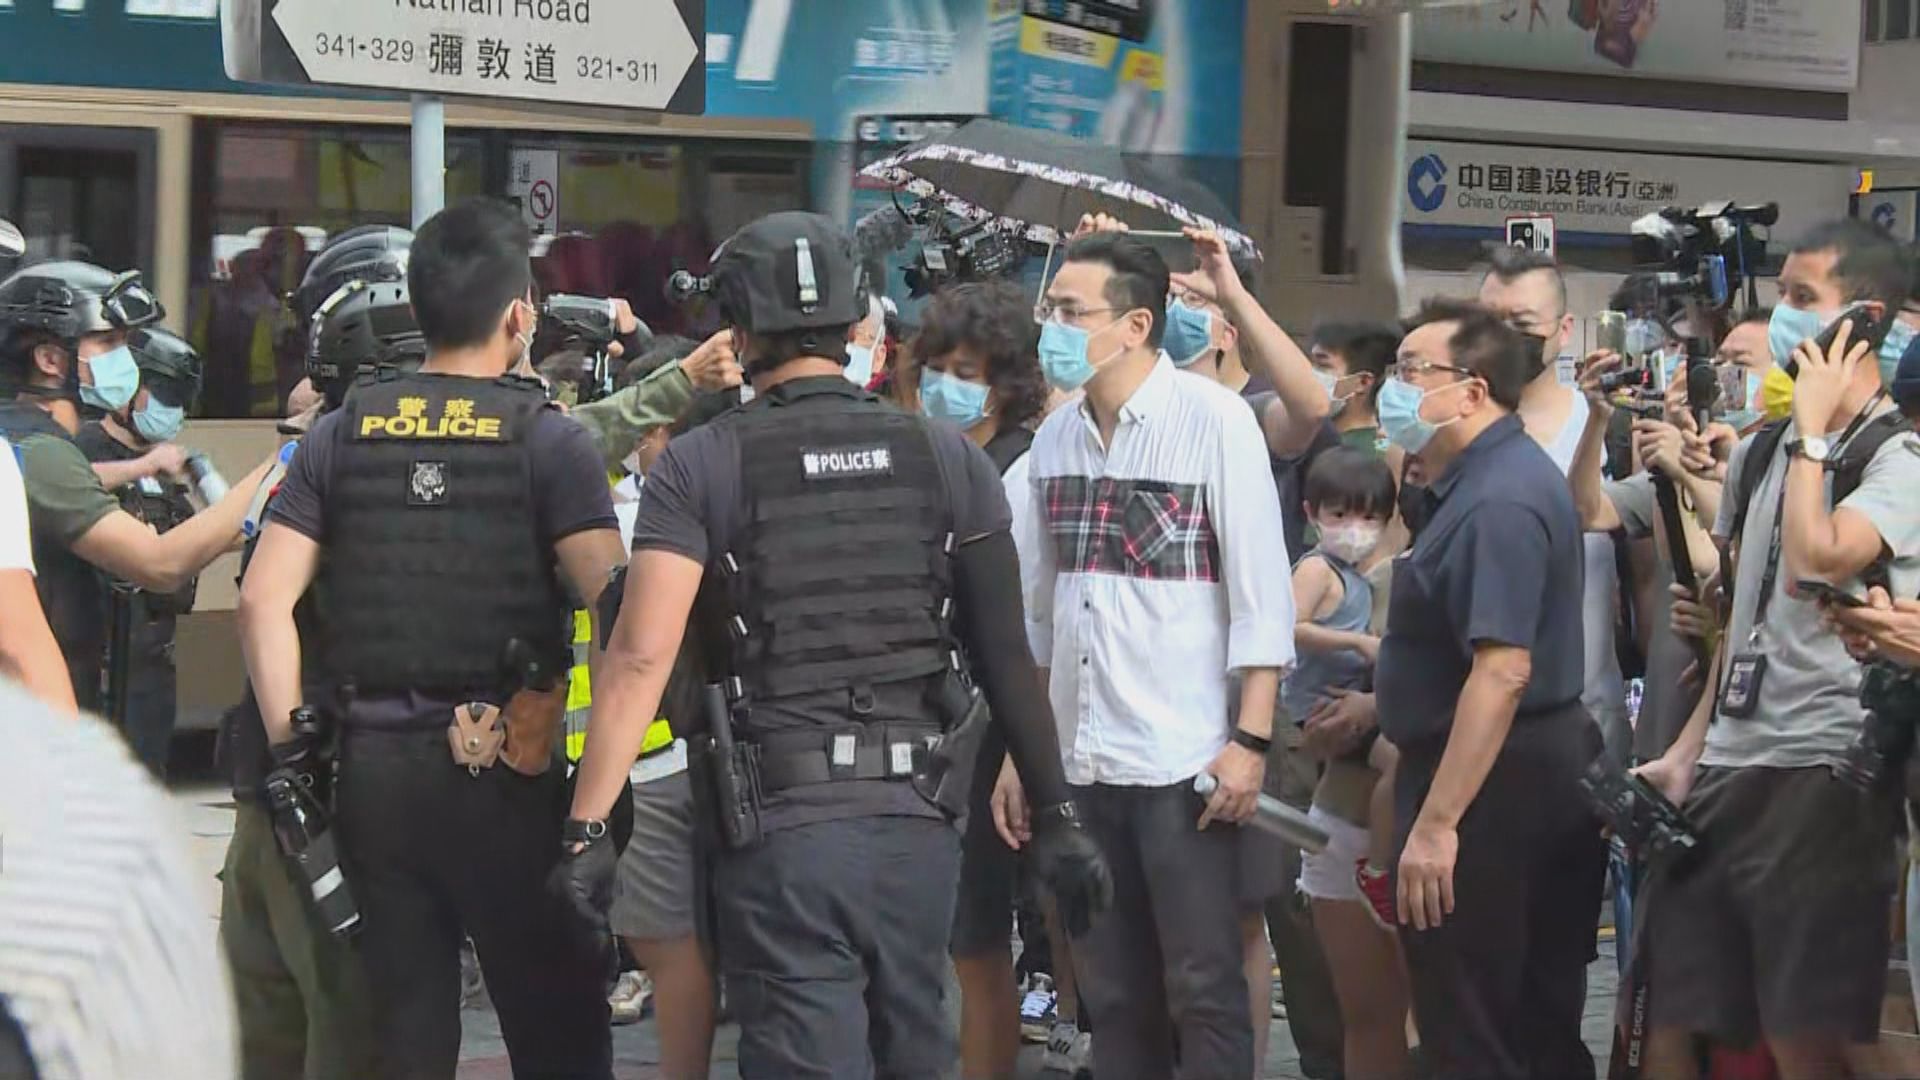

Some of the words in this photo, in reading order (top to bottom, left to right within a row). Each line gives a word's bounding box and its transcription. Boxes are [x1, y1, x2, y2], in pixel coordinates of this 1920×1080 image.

[429, 32, 557, 84] 彌敦道
[1457, 192, 1494, 209] China
[1498, 195, 1573, 213] Construction
[398, 397, 474, 418] 警察
[360, 416, 501, 438] POLICE
